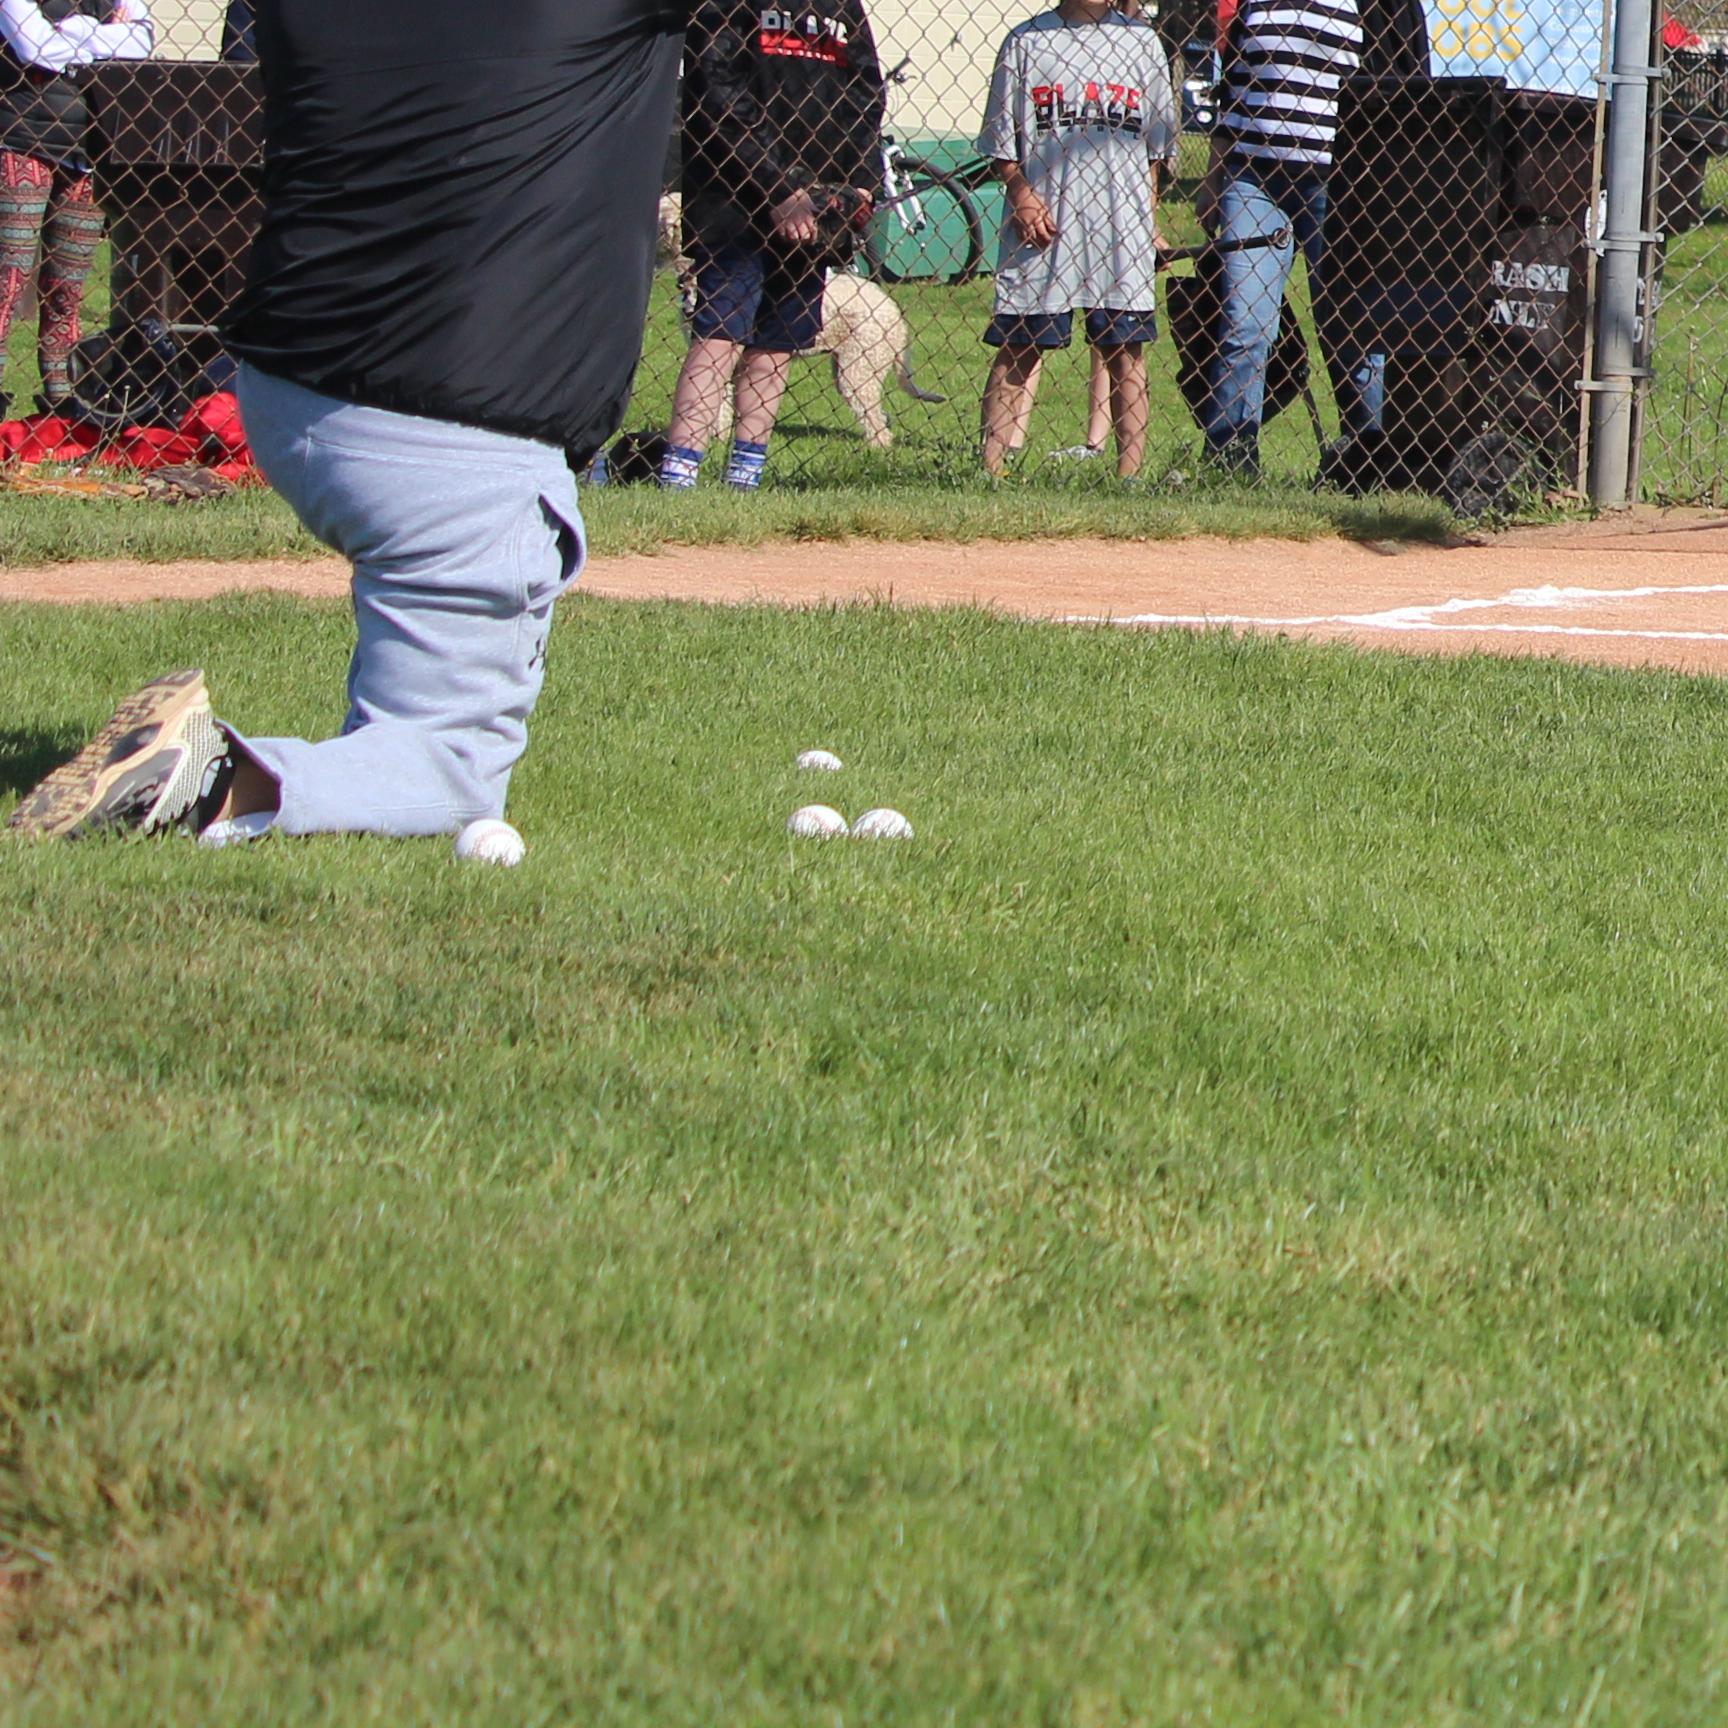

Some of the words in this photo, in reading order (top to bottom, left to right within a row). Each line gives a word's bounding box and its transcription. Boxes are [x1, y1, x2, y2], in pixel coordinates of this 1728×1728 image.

[1431, 20, 1525, 62] OBS
[1031, 80, 1142, 125] BLAZE
[1491, 259, 1570, 293] RASH
[1492, 298, 1556, 330] NLY
